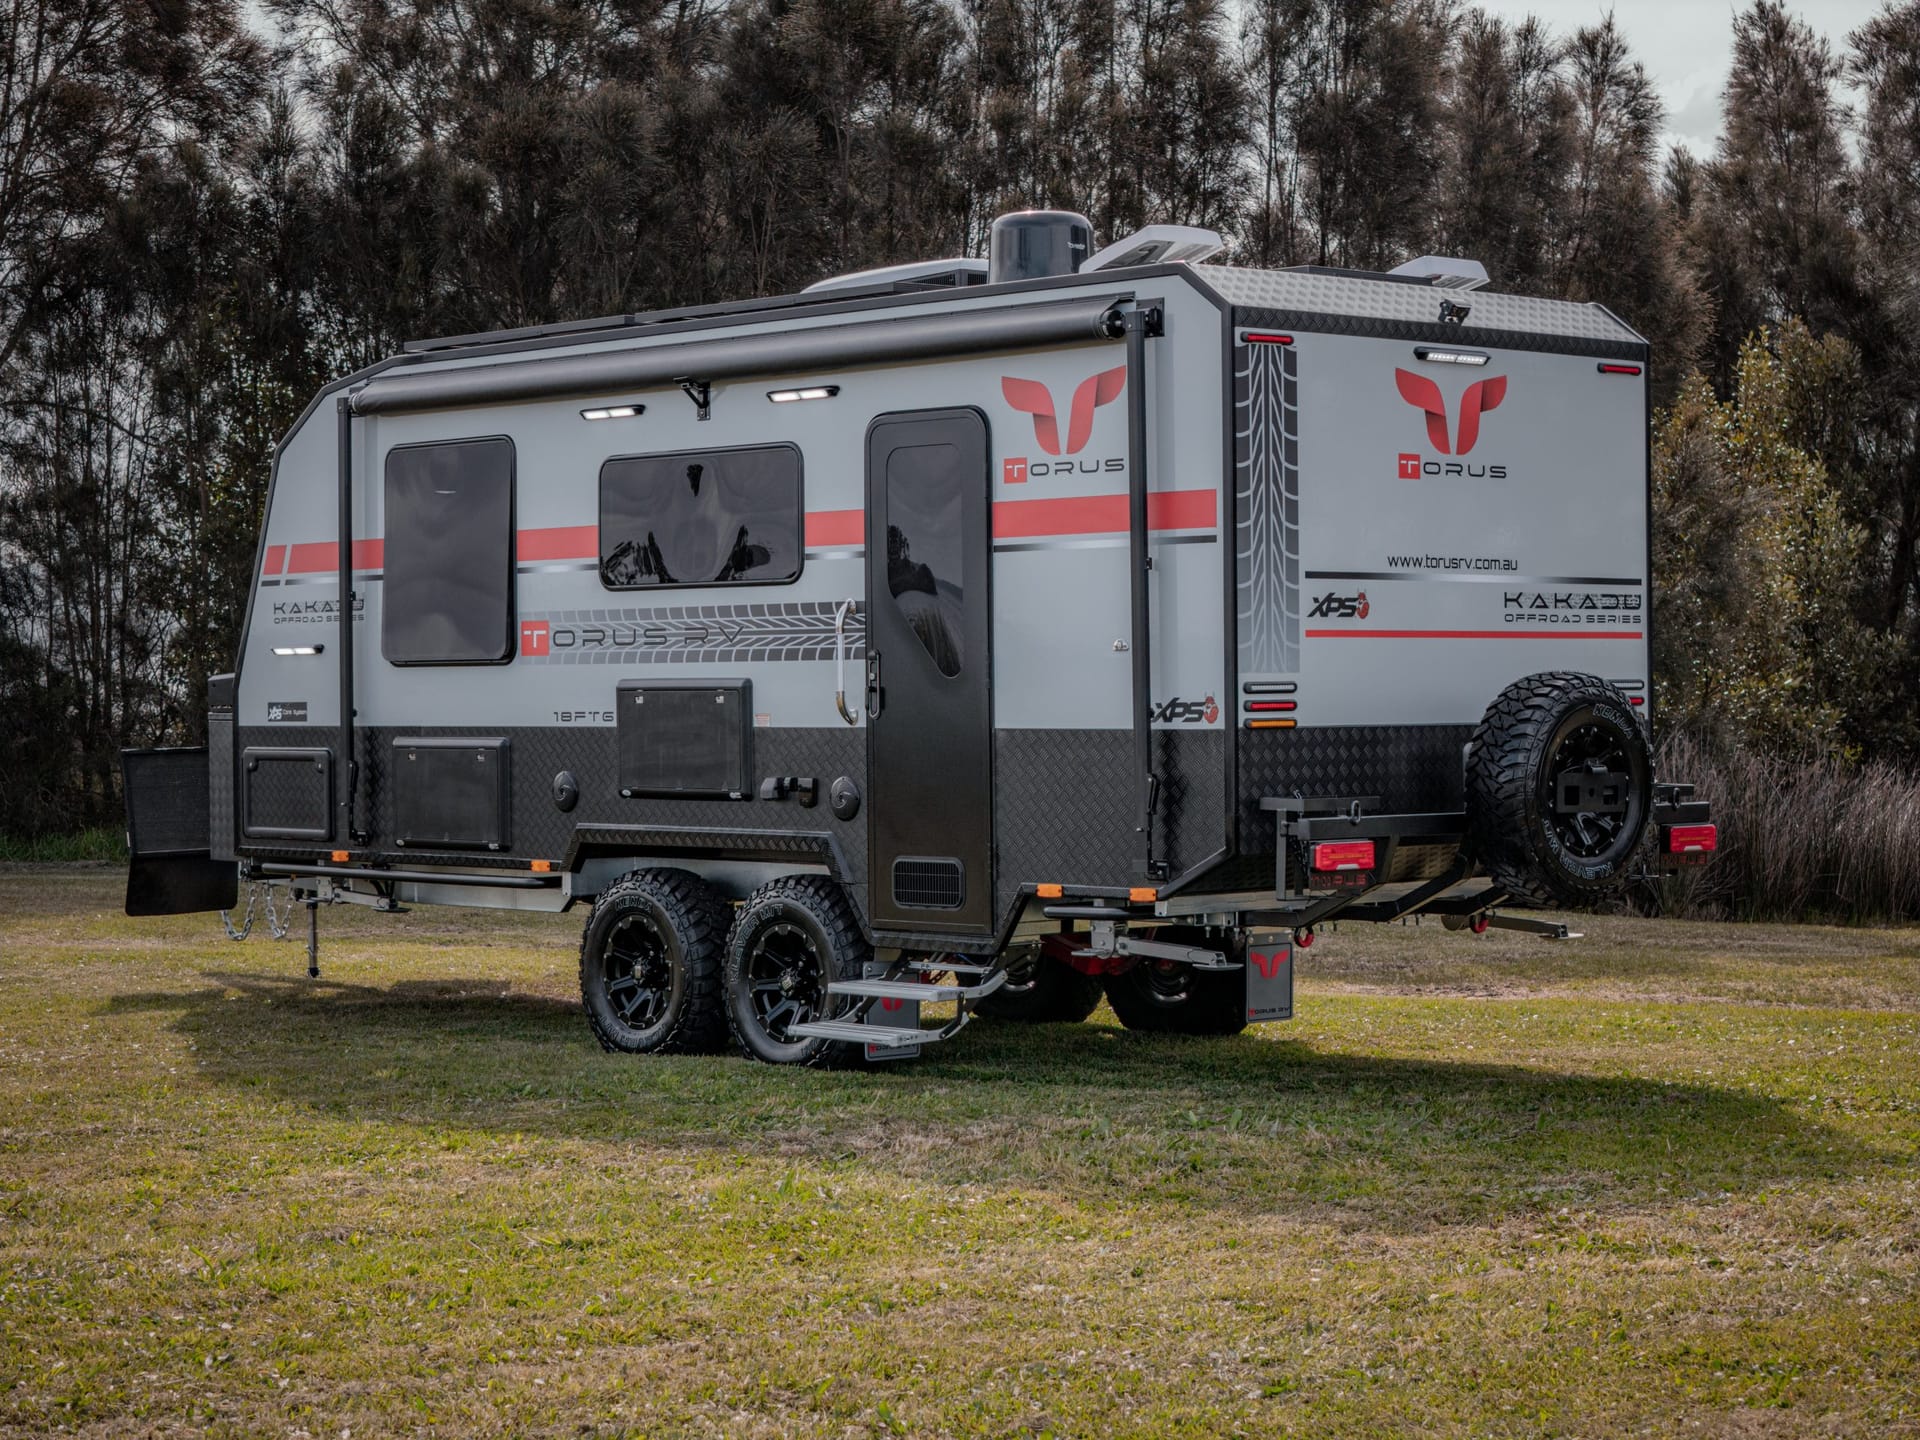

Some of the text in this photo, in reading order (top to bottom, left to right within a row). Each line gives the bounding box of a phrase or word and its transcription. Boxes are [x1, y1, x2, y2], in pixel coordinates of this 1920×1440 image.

[1004, 457, 1125, 484] TORUS
[1399, 454, 1507, 479] TORUS
[1387, 554, 1518, 571] www.torusrv.com.au
[273, 599, 365, 615] KAKAU
[1306, 592, 1359, 617] XPS
[1504, 592, 1642, 610] KAKADU
[1504, 613, 1642, 624] OFFROAD SERIES
[521, 621, 745, 656] TORUS RV
[1151, 697, 1206, 723] XPS
